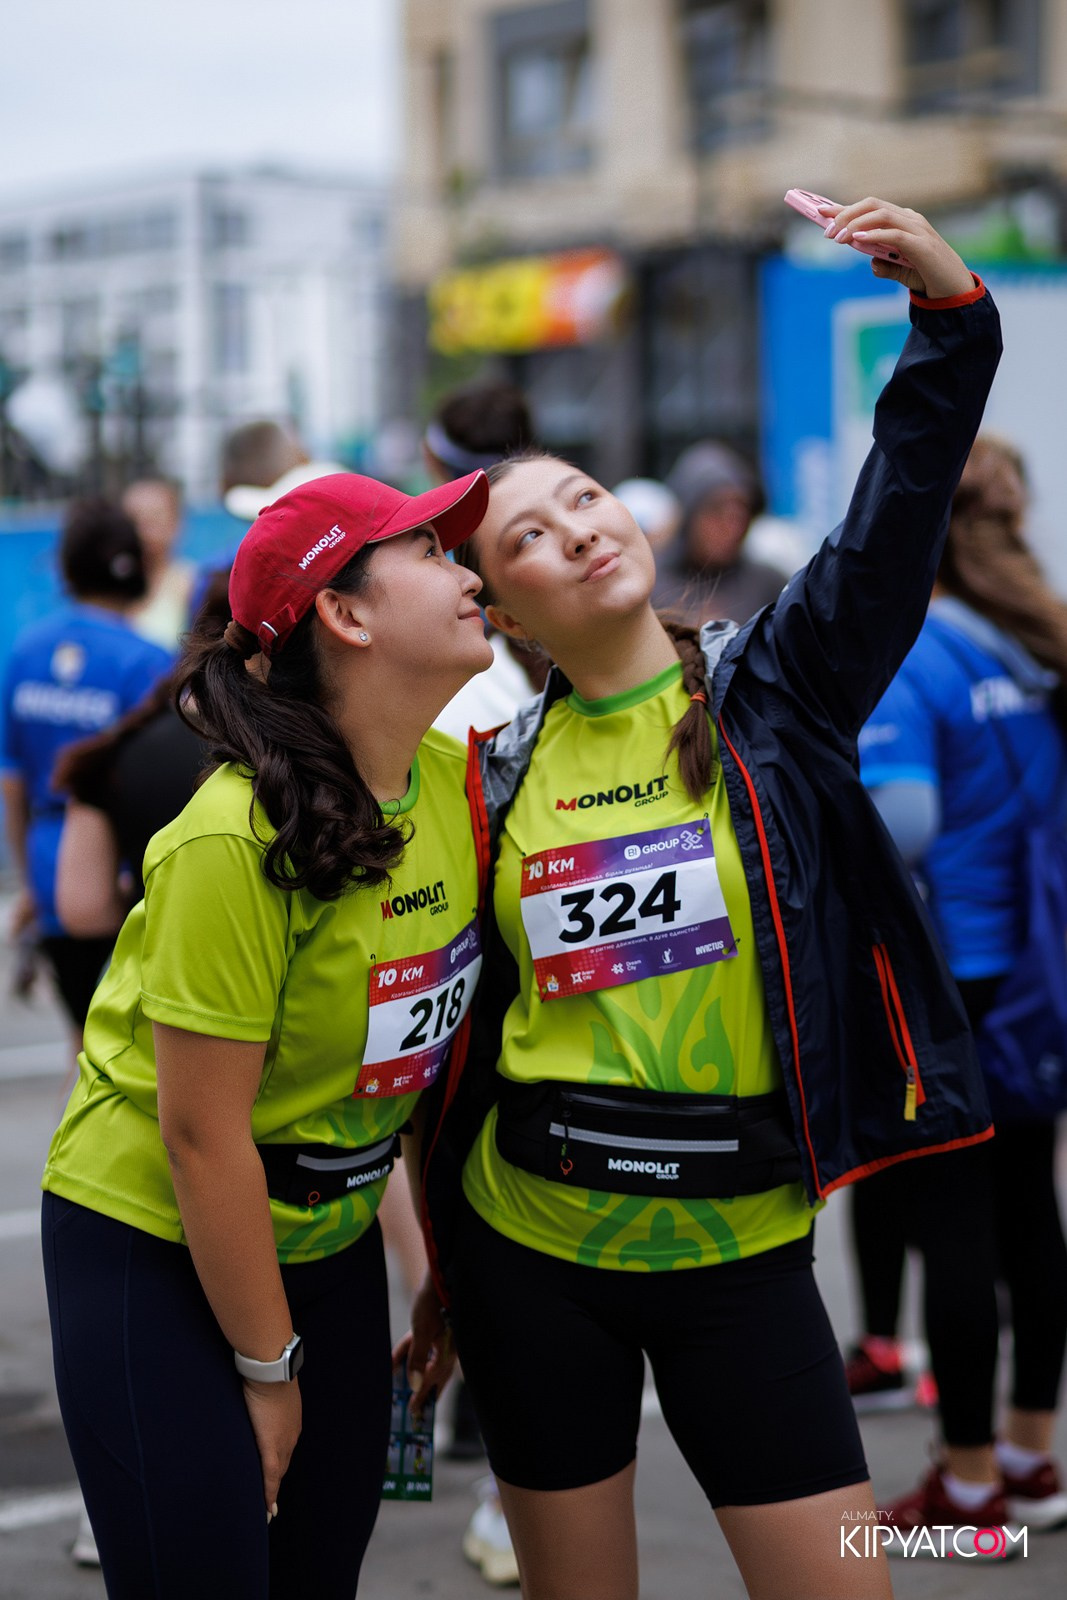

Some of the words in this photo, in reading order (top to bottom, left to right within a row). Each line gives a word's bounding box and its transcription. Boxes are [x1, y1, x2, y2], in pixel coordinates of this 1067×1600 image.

[298, 524, 342, 571] MONOLIT
[328, 531, 346, 549] GROUP
[555, 775, 669, 811] MONOLIT
[634, 790, 669, 808] GROUP
[642, 838, 680, 854] GROUP
[528, 860, 544, 880] 10
[548, 857, 575, 875] KM
[380, 880, 446, 922] MONOLIT
[558, 870, 682, 943] 324
[695, 940, 725, 956] INVICTUS
[377, 967, 397, 989] 10
[401, 965, 424, 984] KM
[399, 977, 465, 1052] 218
[346, 1164, 391, 1189] MONOLIT
[607, 1158, 680, 1175] MONOLIT
[655, 1173, 680, 1181] GROUP
